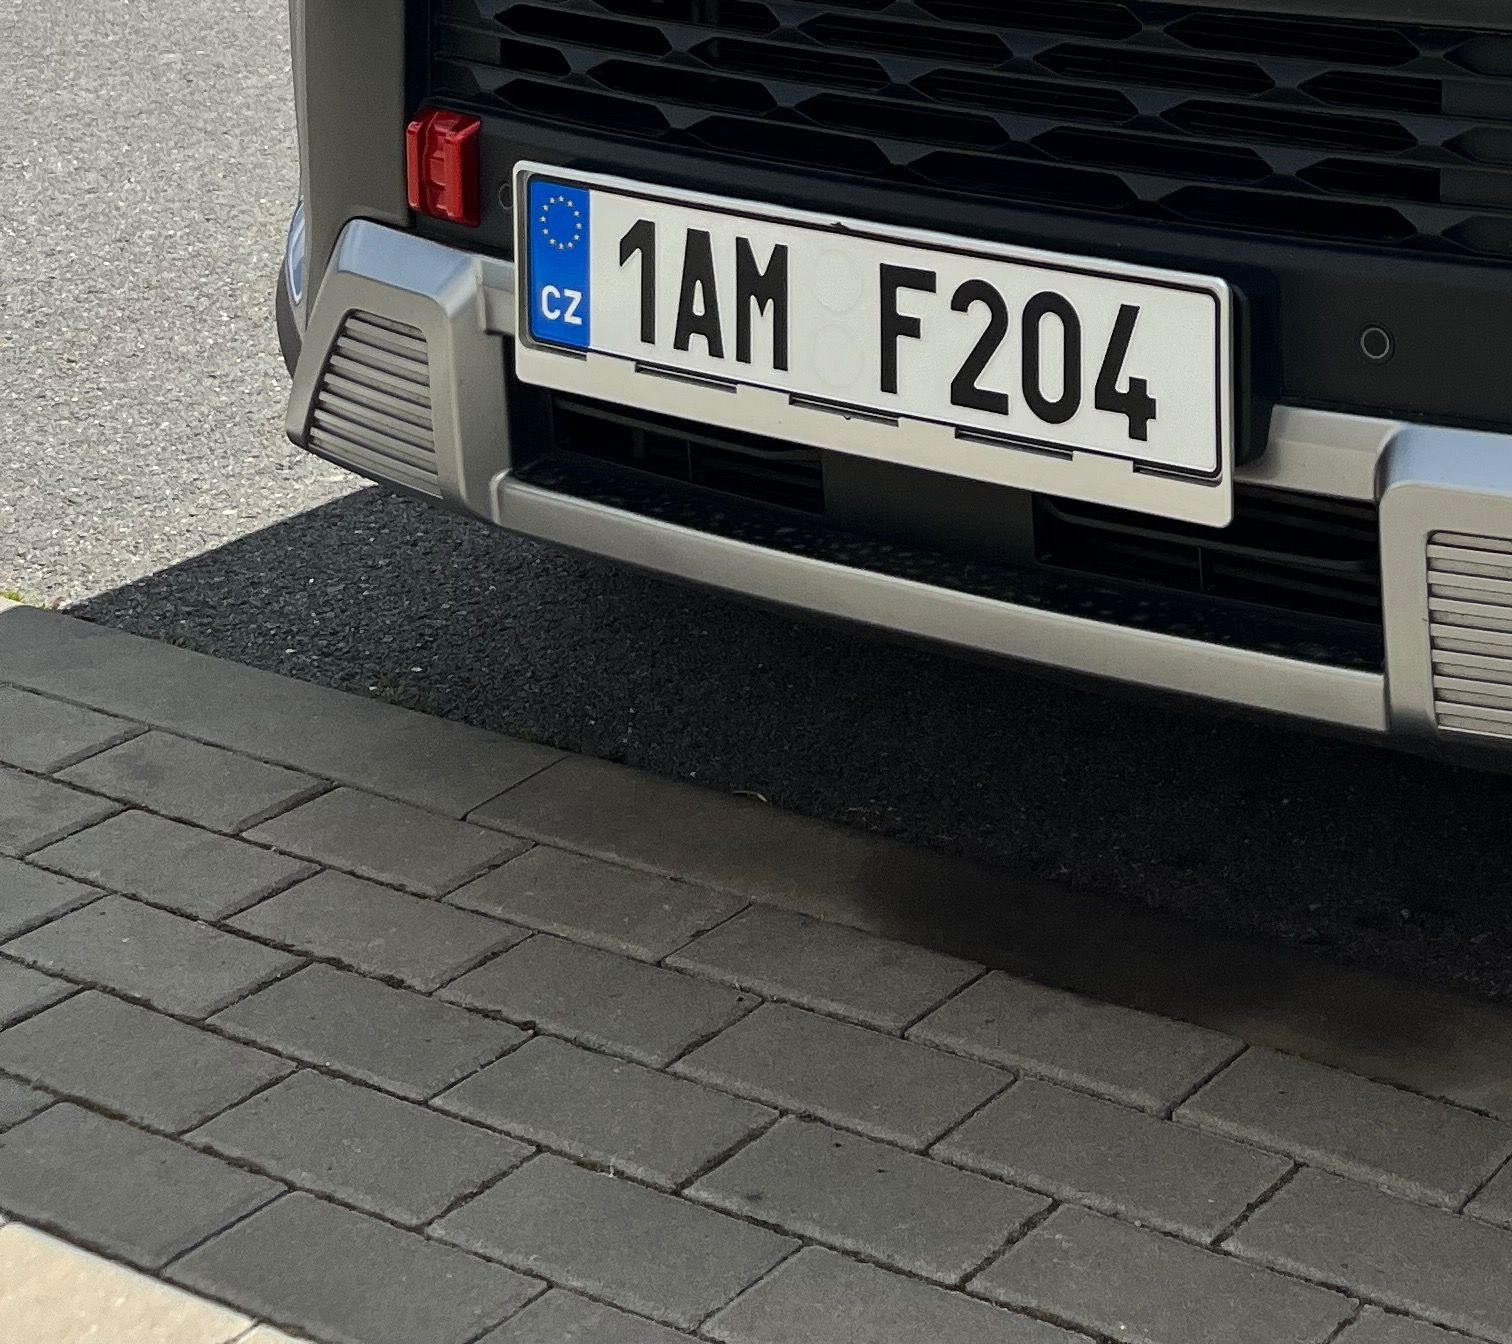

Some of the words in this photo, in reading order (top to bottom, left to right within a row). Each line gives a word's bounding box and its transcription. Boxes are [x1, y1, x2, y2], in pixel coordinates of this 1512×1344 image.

[541, 285, 583, 327] CZ
[619, 219, 789, 371] 1AM
[879, 263, 1156, 442] F204
